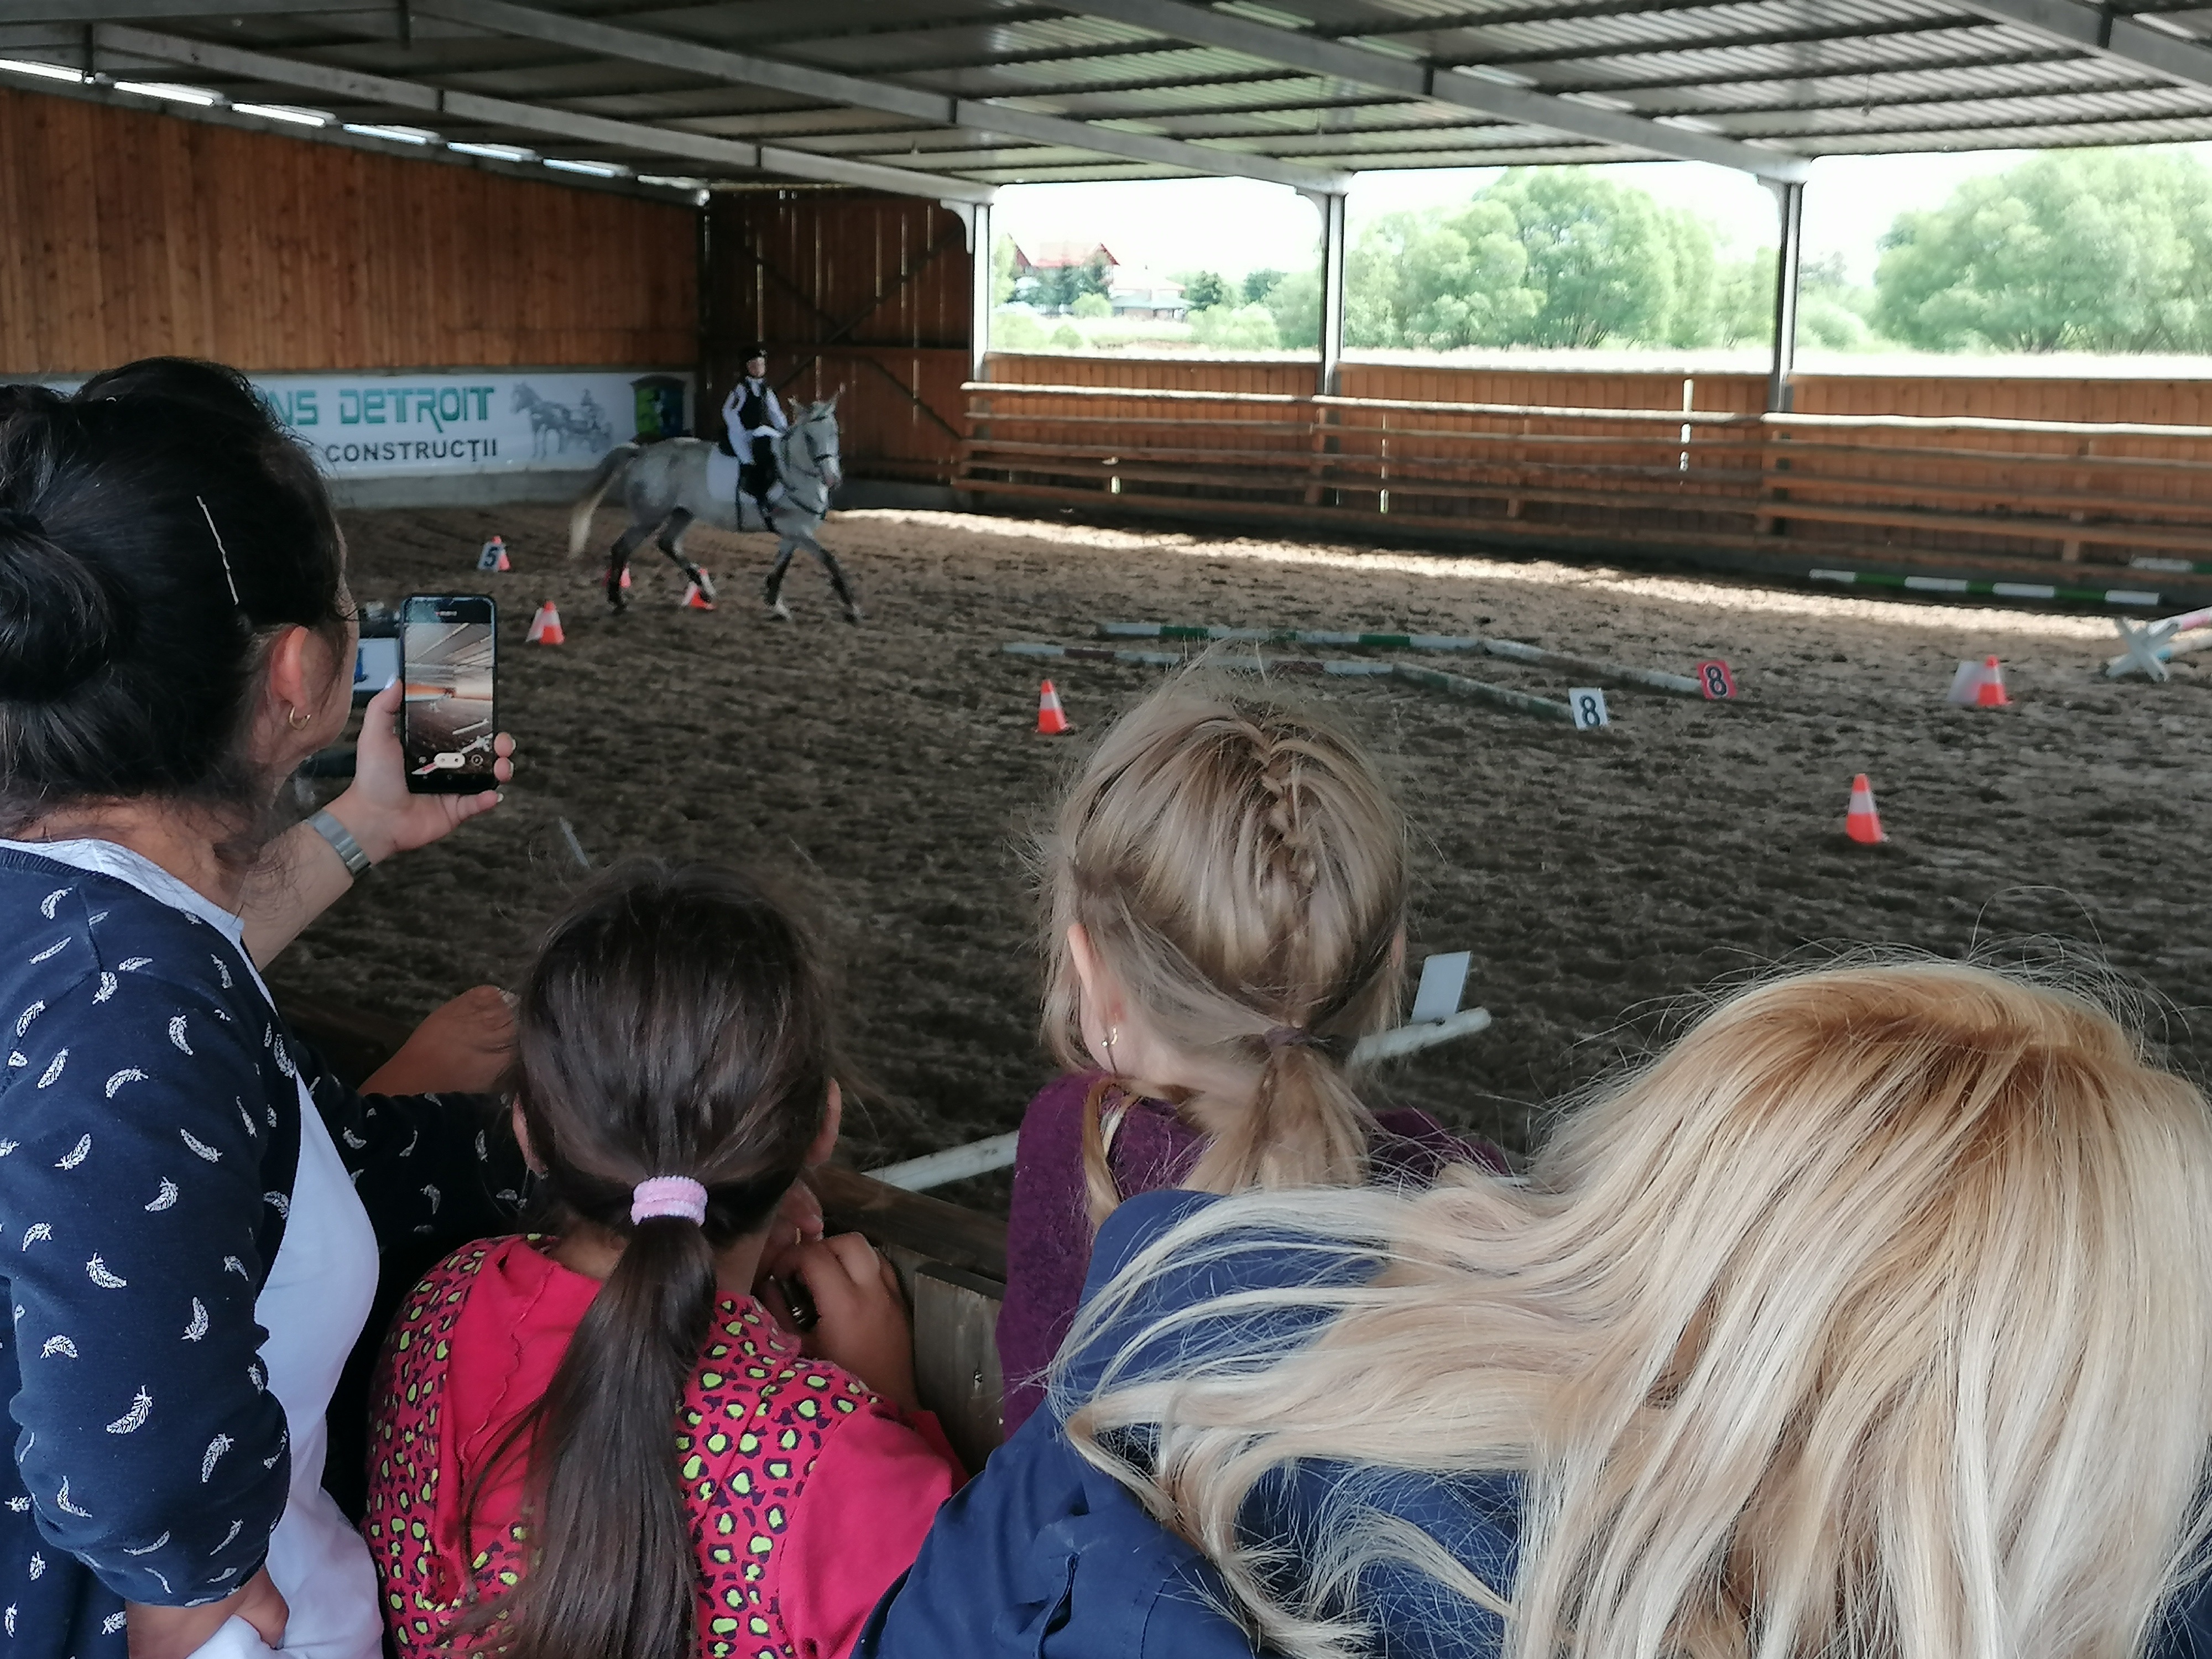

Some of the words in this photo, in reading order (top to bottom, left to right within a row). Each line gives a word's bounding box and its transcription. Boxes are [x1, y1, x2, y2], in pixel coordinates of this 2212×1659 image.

[257, 390, 318, 425] NS
[339, 387, 494, 433] DETROIT
[483, 546, 500, 567] 5
[1704, 664, 1728, 697] 8
[1579, 695, 1600, 727] 8
